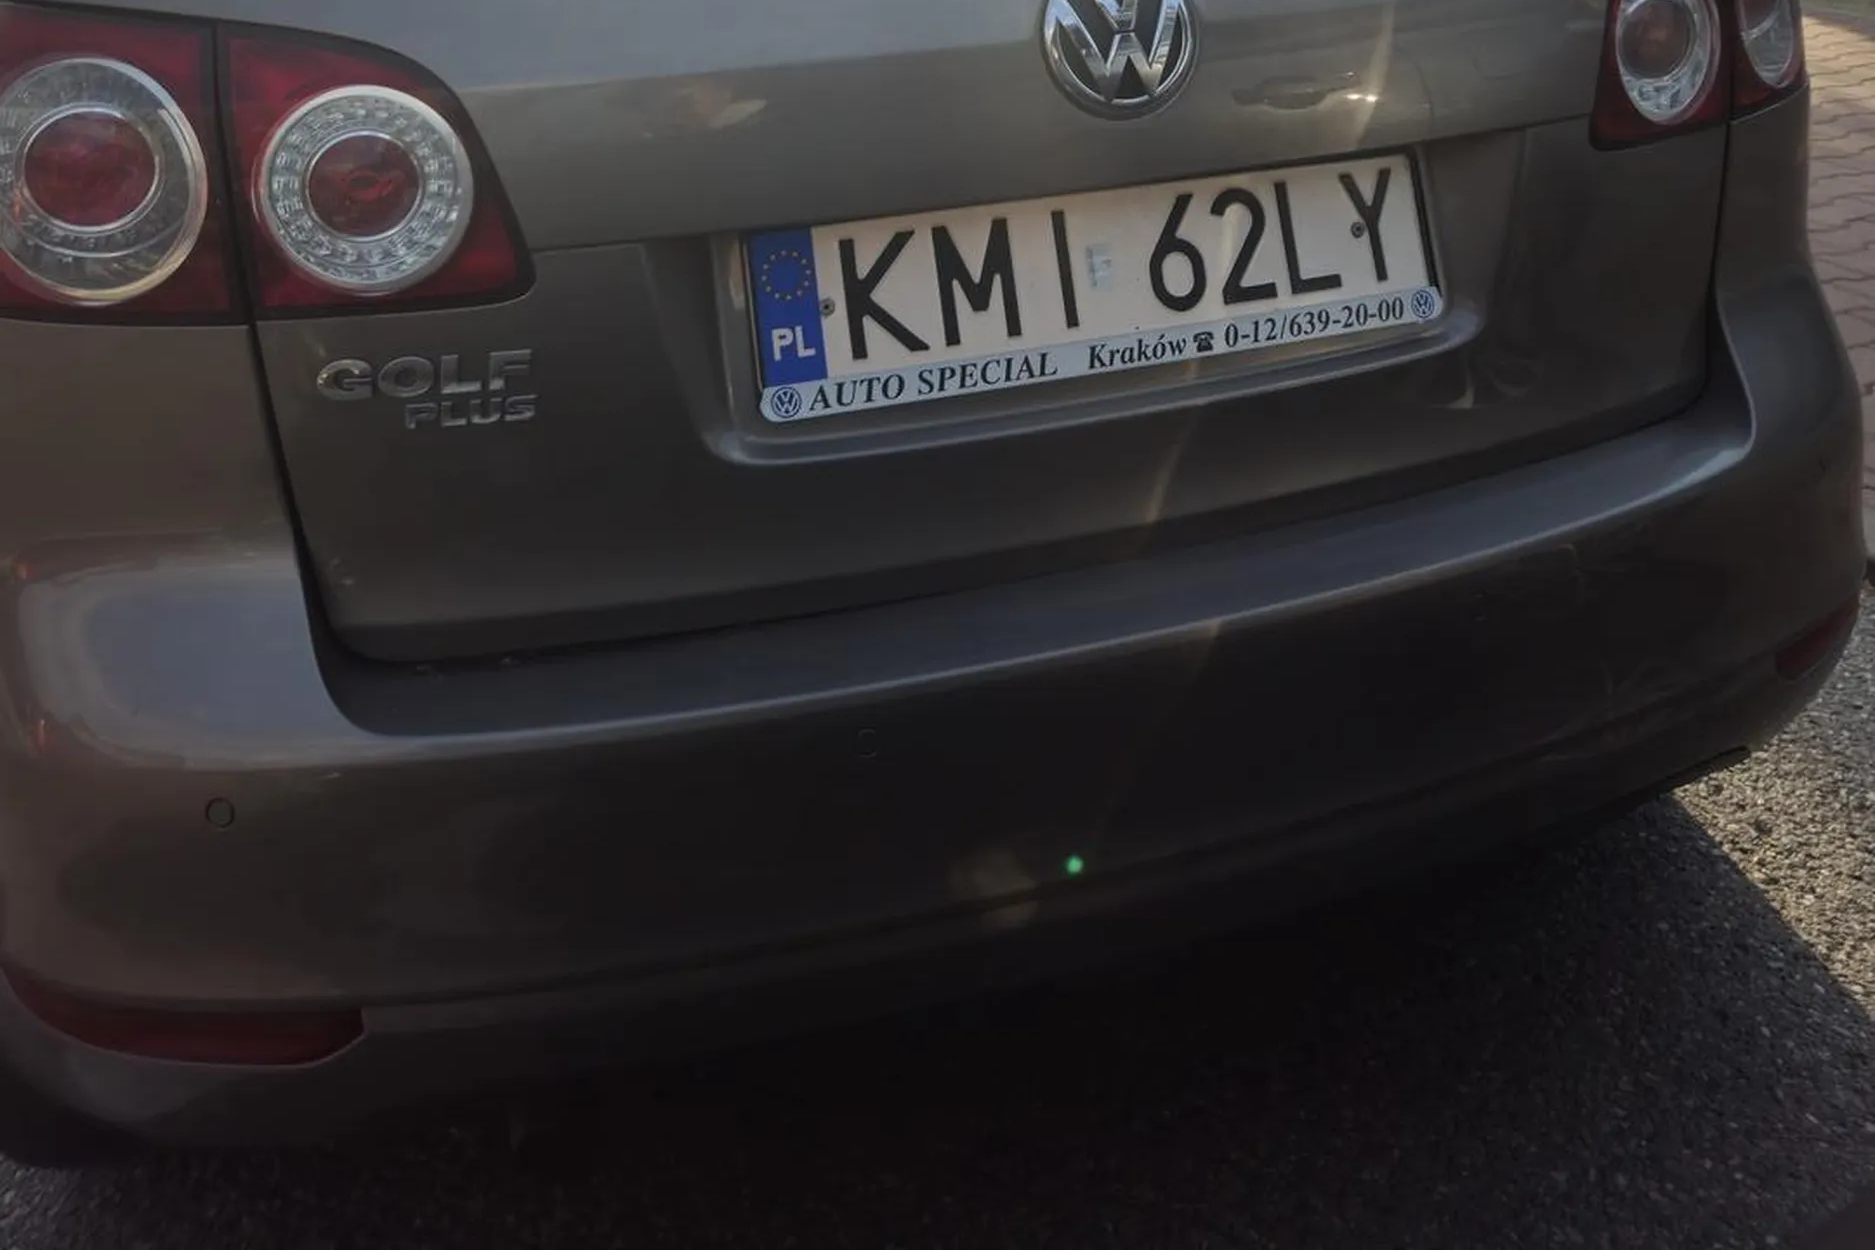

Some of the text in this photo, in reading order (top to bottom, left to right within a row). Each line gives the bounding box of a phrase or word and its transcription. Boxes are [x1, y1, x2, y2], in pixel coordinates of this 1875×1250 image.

[838, 167, 1394, 361] KMI 62LY
[771, 325, 816, 362] PL
[808, 373, 906, 411] AUTO
[916, 351, 1059, 396] SPECIAL
[1087, 332, 1187, 370] Kraków
[1224, 296, 1405, 350] 0-12/639-20-00
[316, 349, 532, 400] GOLF
[404, 394, 538, 430] PLUS
